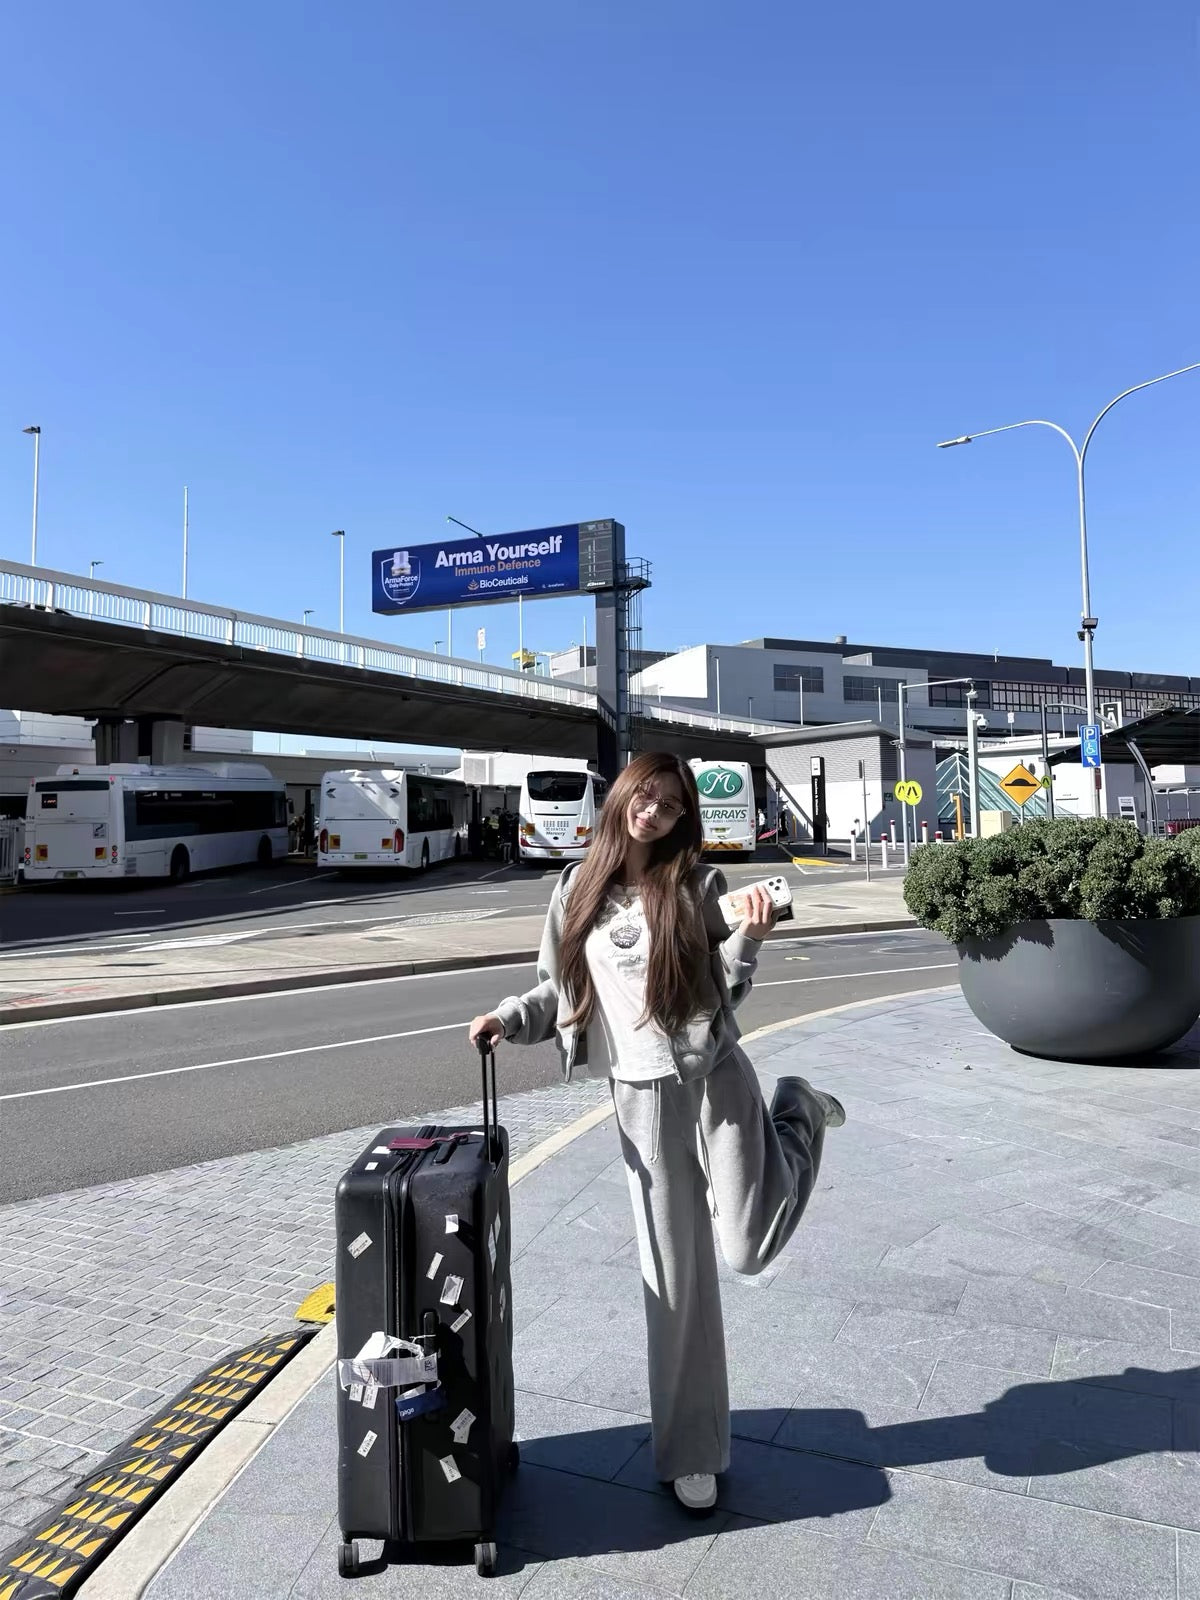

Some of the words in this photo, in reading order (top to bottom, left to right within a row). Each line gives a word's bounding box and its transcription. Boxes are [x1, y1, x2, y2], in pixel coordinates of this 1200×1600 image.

[434, 549, 483, 569] Arma
[486, 535, 563, 561] Yourself
[454, 565, 496, 577] Immune
[497, 558, 541, 572] Defence
[384, 575, 418, 585] ArmaForce
[479, 574, 529, 589] BioCeuticals
[1085, 728, 1094, 740] P
